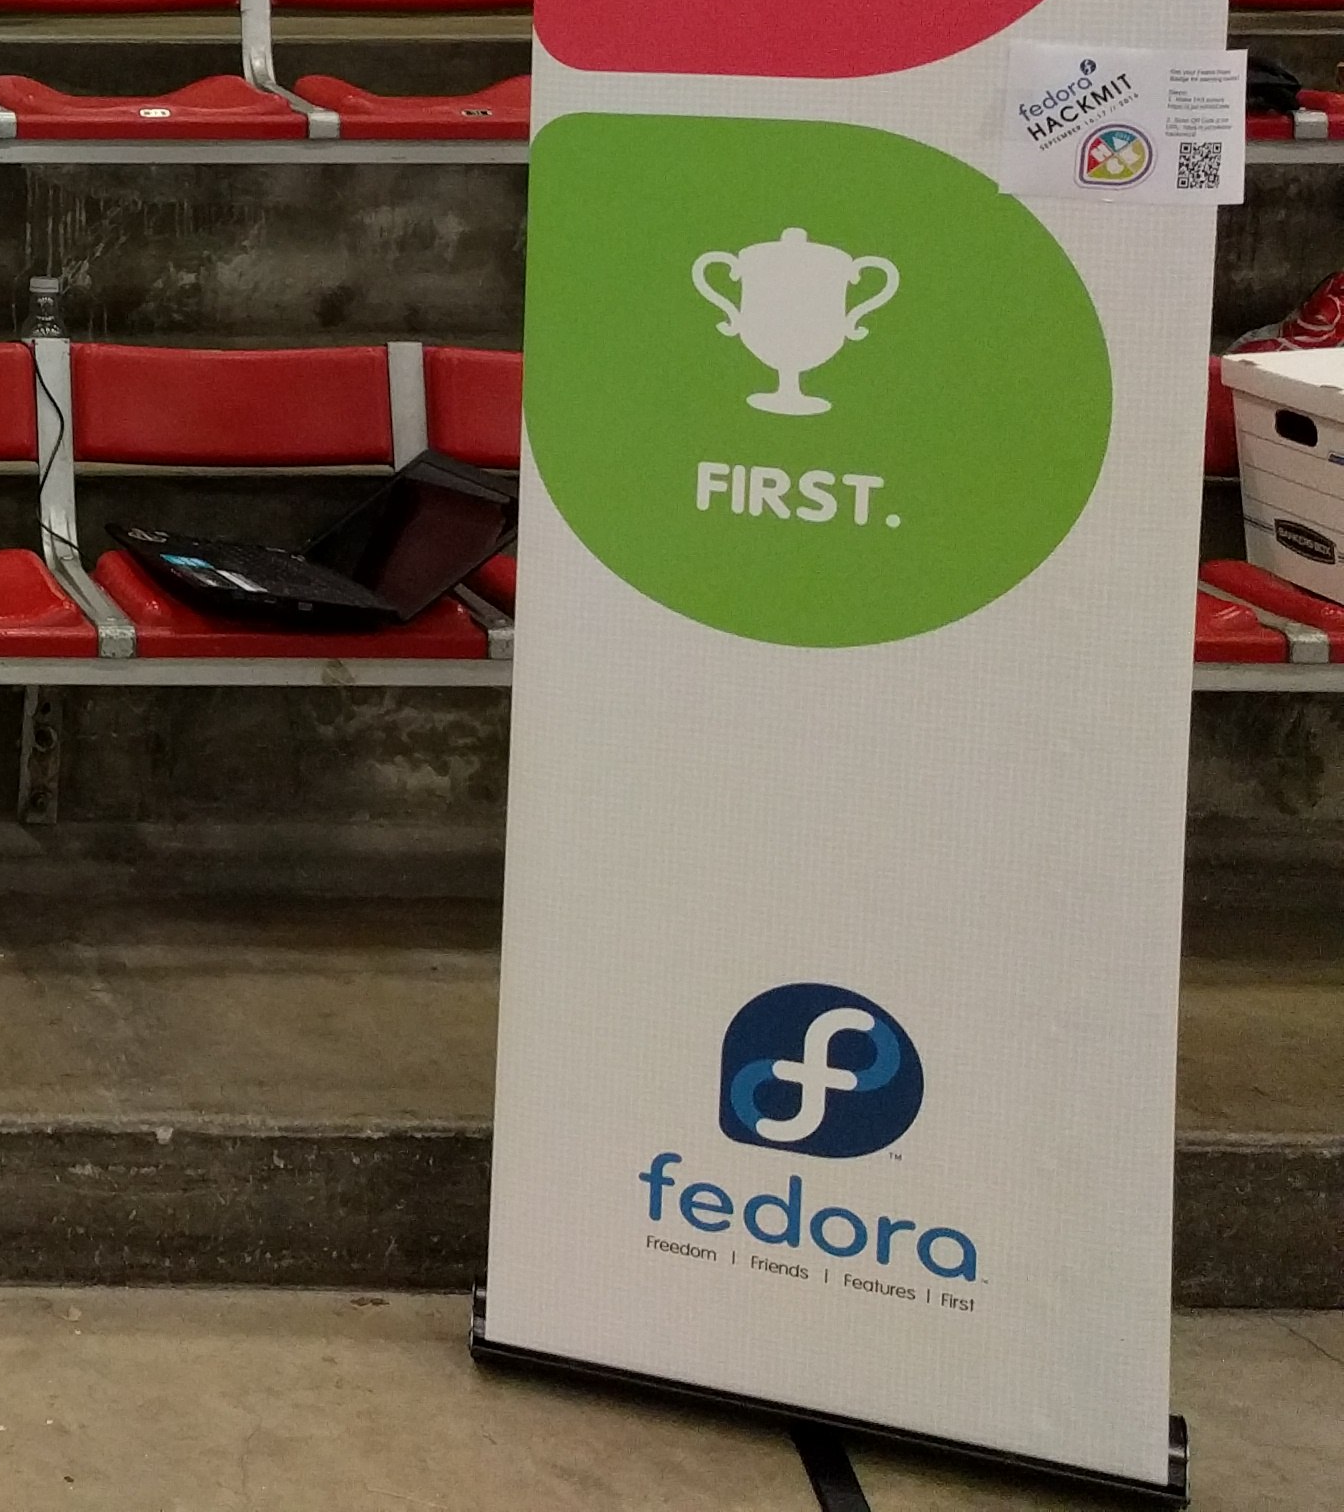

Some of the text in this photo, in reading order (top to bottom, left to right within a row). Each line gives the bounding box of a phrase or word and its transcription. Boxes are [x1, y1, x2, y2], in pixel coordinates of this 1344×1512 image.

[1019, 77, 1093, 121] fedora
[1027, 74, 1132, 141] HACKMIT
[1039, 125, 1081, 151] SEPTEMBER
[696, 461, 901, 528] FIRST.
[638, 1152, 977, 1282] fedora
[646, 1235, 717, 1261] Freedom
[750, 1255, 809, 1280] Friends
[844, 1273, 916, 1300] Features
[941, 1293, 975, 1312] First
